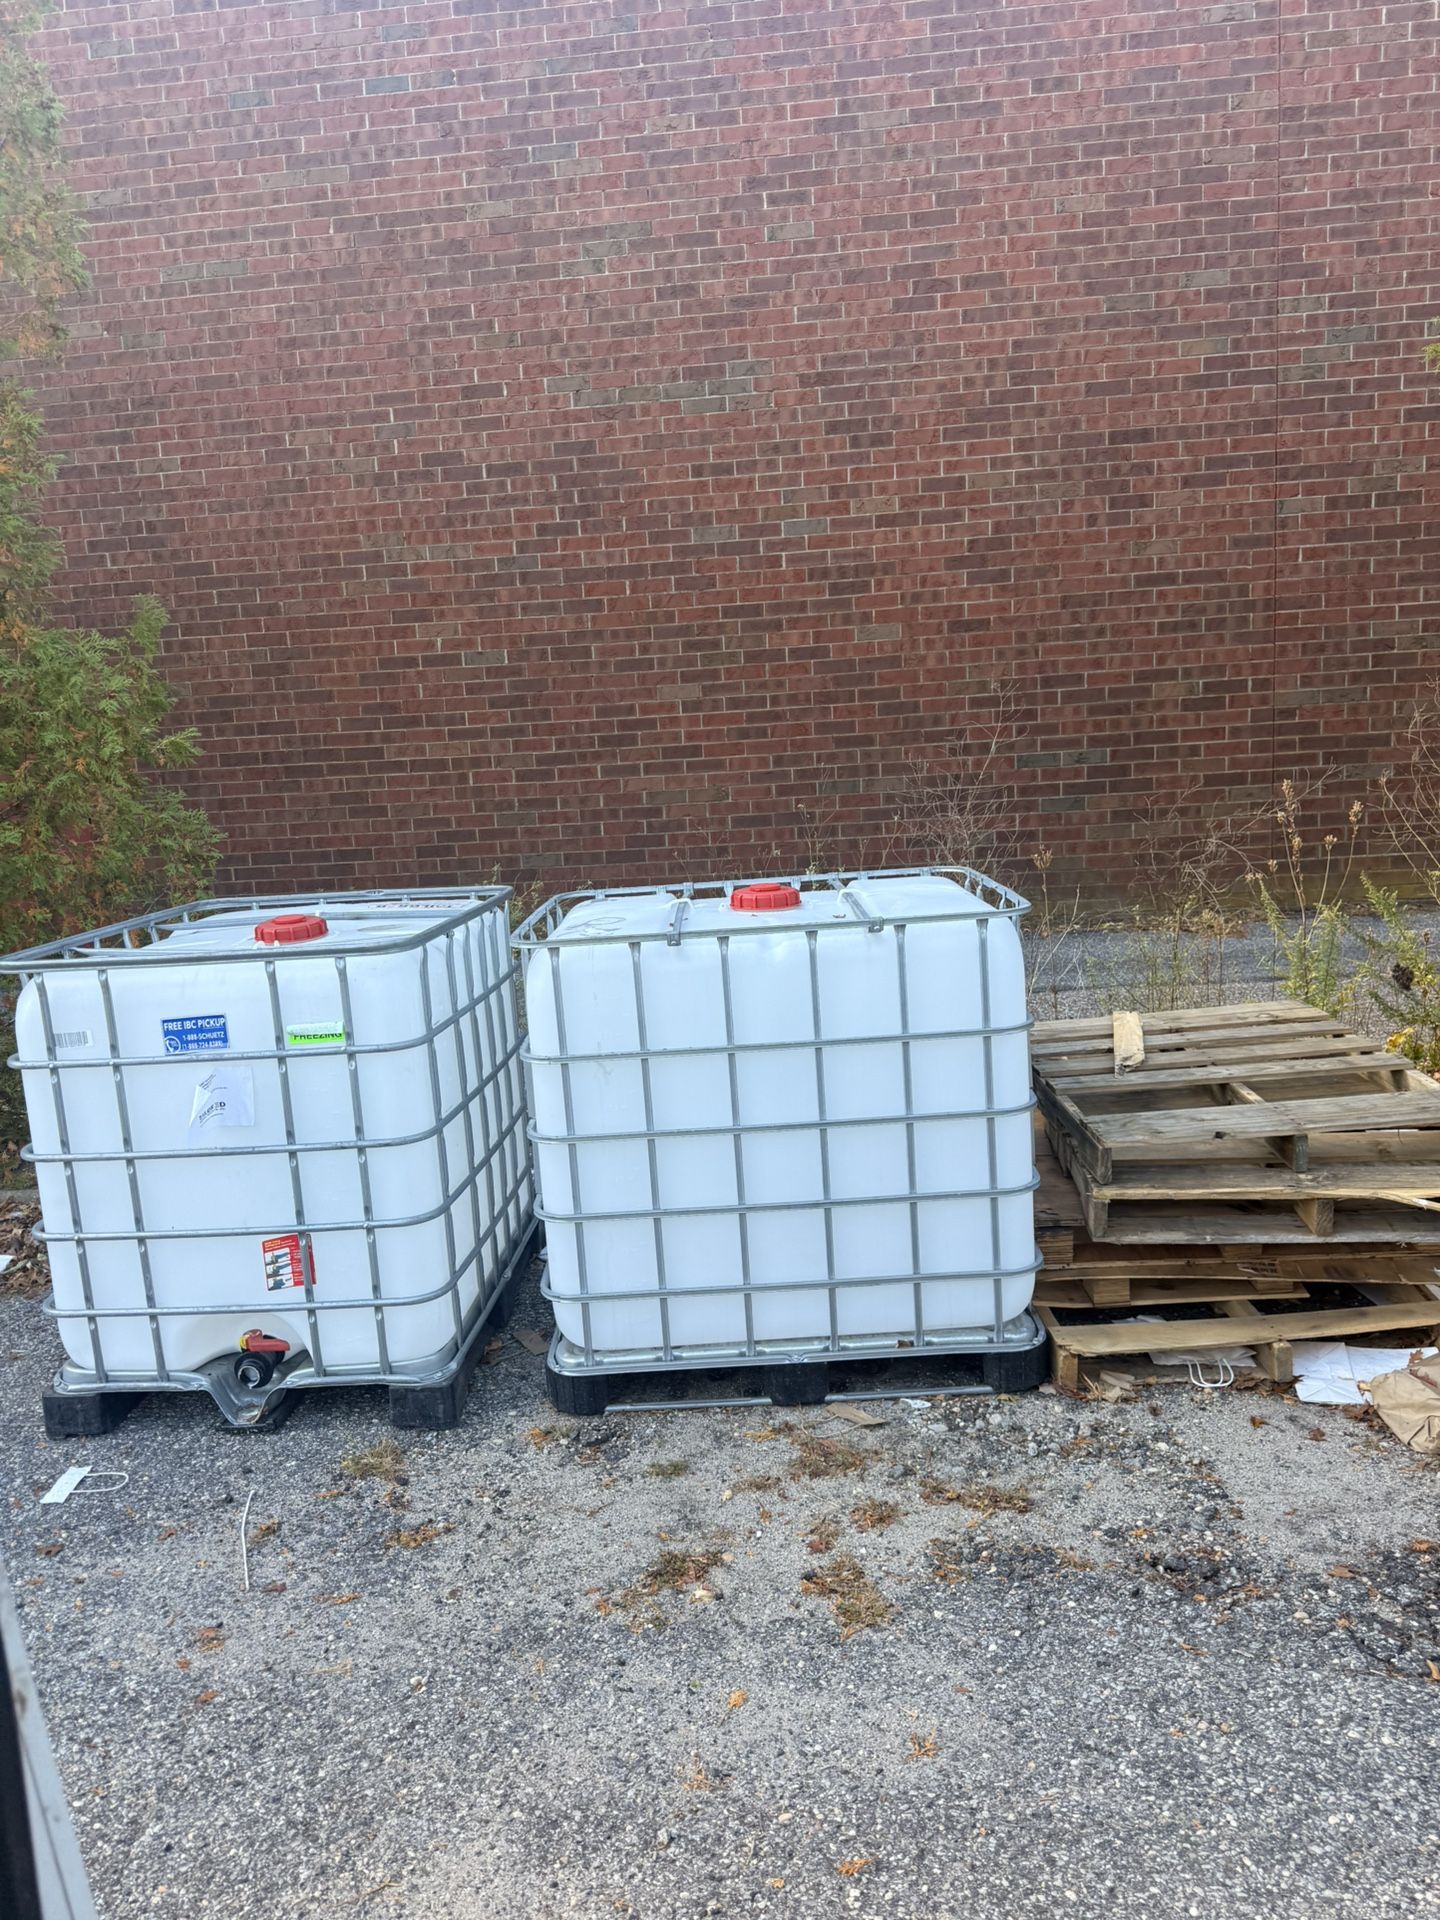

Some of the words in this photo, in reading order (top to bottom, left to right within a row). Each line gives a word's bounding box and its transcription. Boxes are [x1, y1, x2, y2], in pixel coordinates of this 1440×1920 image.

[164, 1021, 182, 1031] FREE
[183, 1020, 197, 1030] IBC
[197, 1017, 225, 1028] PICKUP
